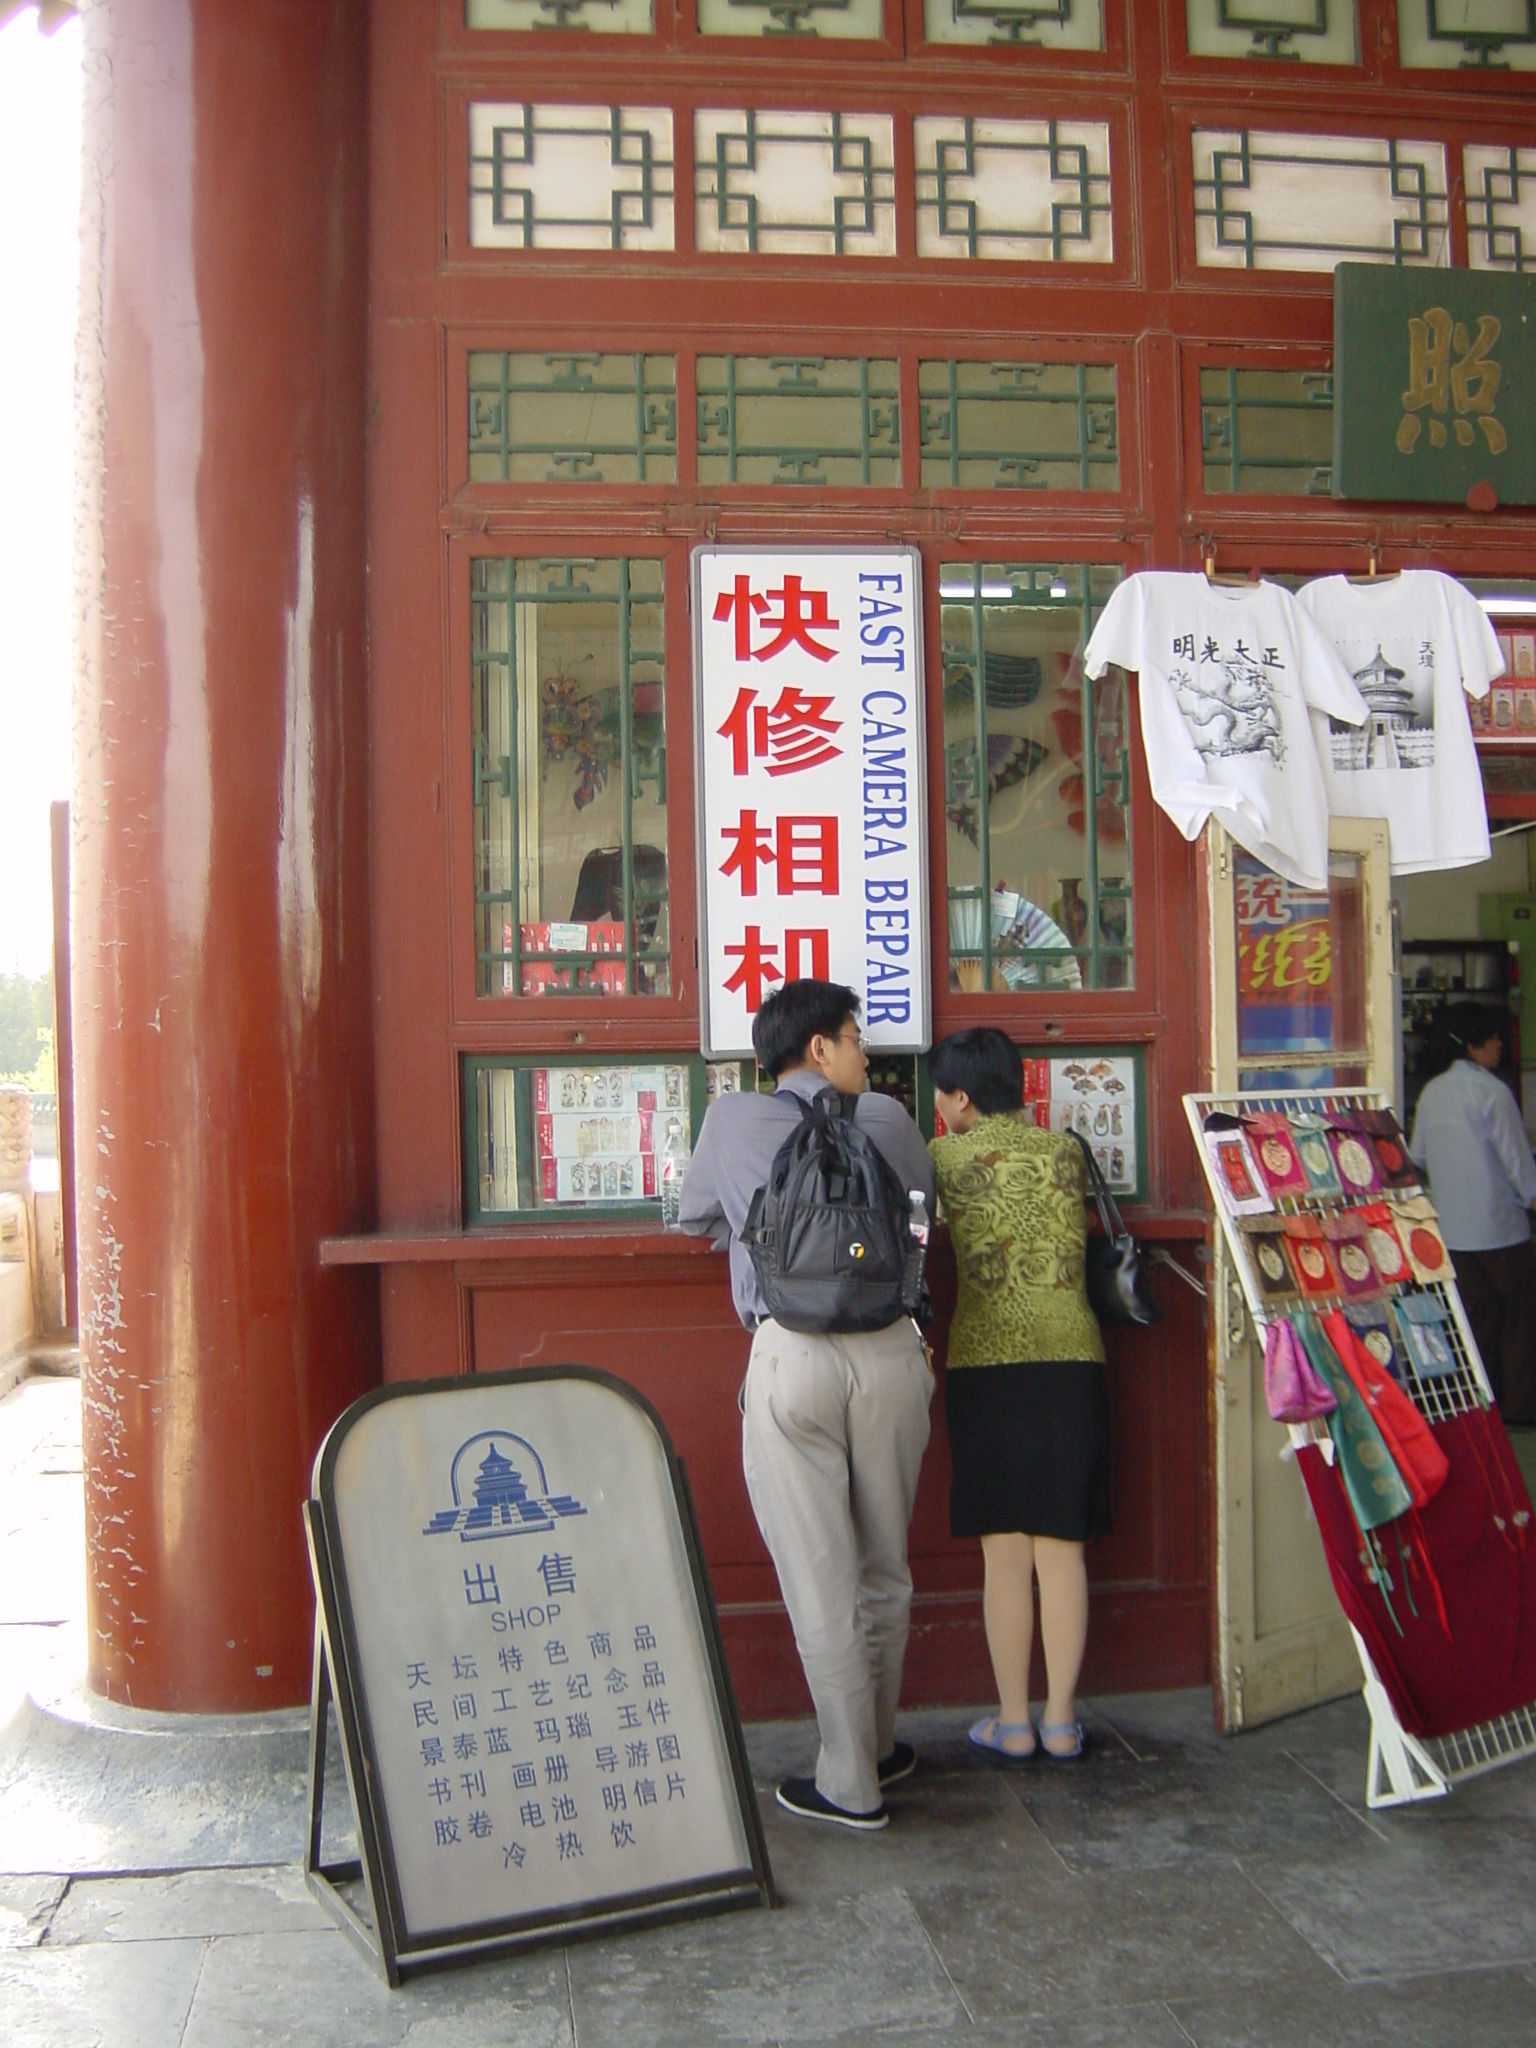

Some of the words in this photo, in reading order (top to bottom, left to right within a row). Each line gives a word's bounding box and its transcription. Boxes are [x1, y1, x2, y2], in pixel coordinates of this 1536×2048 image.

[1396, 307, 1507, 455] 照
[858, 572, 906, 672] FAST
[712, 574, 844, 1013] 快修相机
[861, 690, 908, 860] CAMERA
[463, 1551, 577, 1606] 出售
[490, 1604, 562, 1632] SHOP
[407, 1625, 658, 1690] 天坛特色商品
[412, 1661, 667, 1729] 民间工艺纪念品
[420, 1726, 512, 1767] 景泰蓝
[533, 1711, 593, 1745] 玛瑙
[616, 1697, 672, 1731] 玉件
[427, 1768, 488, 1806] 书刊
[511, 1754, 570, 1790] 画册
[595, 1733, 682, 1774] 导游图
[434, 1810, 493, 1847] 胶卷
[519, 1793, 579, 1829] 电池
[601, 1771, 687, 1813] 明信片
[502, 1819, 637, 1869] 冷热饮
